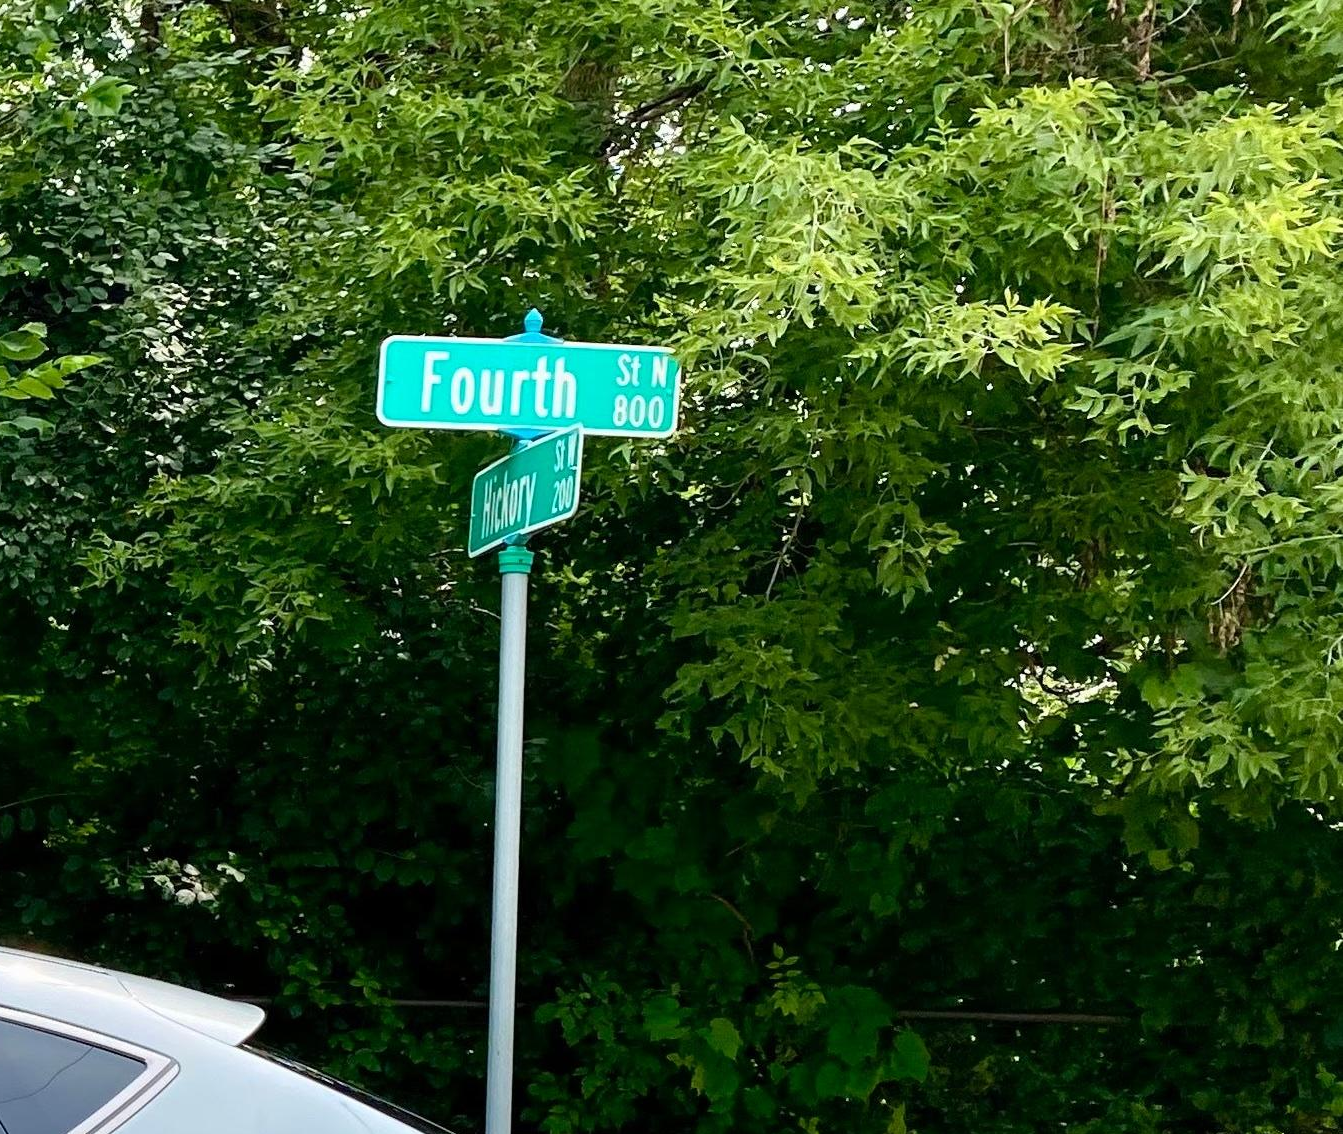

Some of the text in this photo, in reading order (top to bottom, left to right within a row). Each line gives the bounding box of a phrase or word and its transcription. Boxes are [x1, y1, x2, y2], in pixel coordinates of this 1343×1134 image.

[420, 351, 578, 419] Fourth
[616, 353, 669, 389] St N
[612, 395, 666, 430] 800
[554, 432, 578, 473] St W
[481, 470, 538, 540] Hickory
[551, 475, 575, 515] 200
